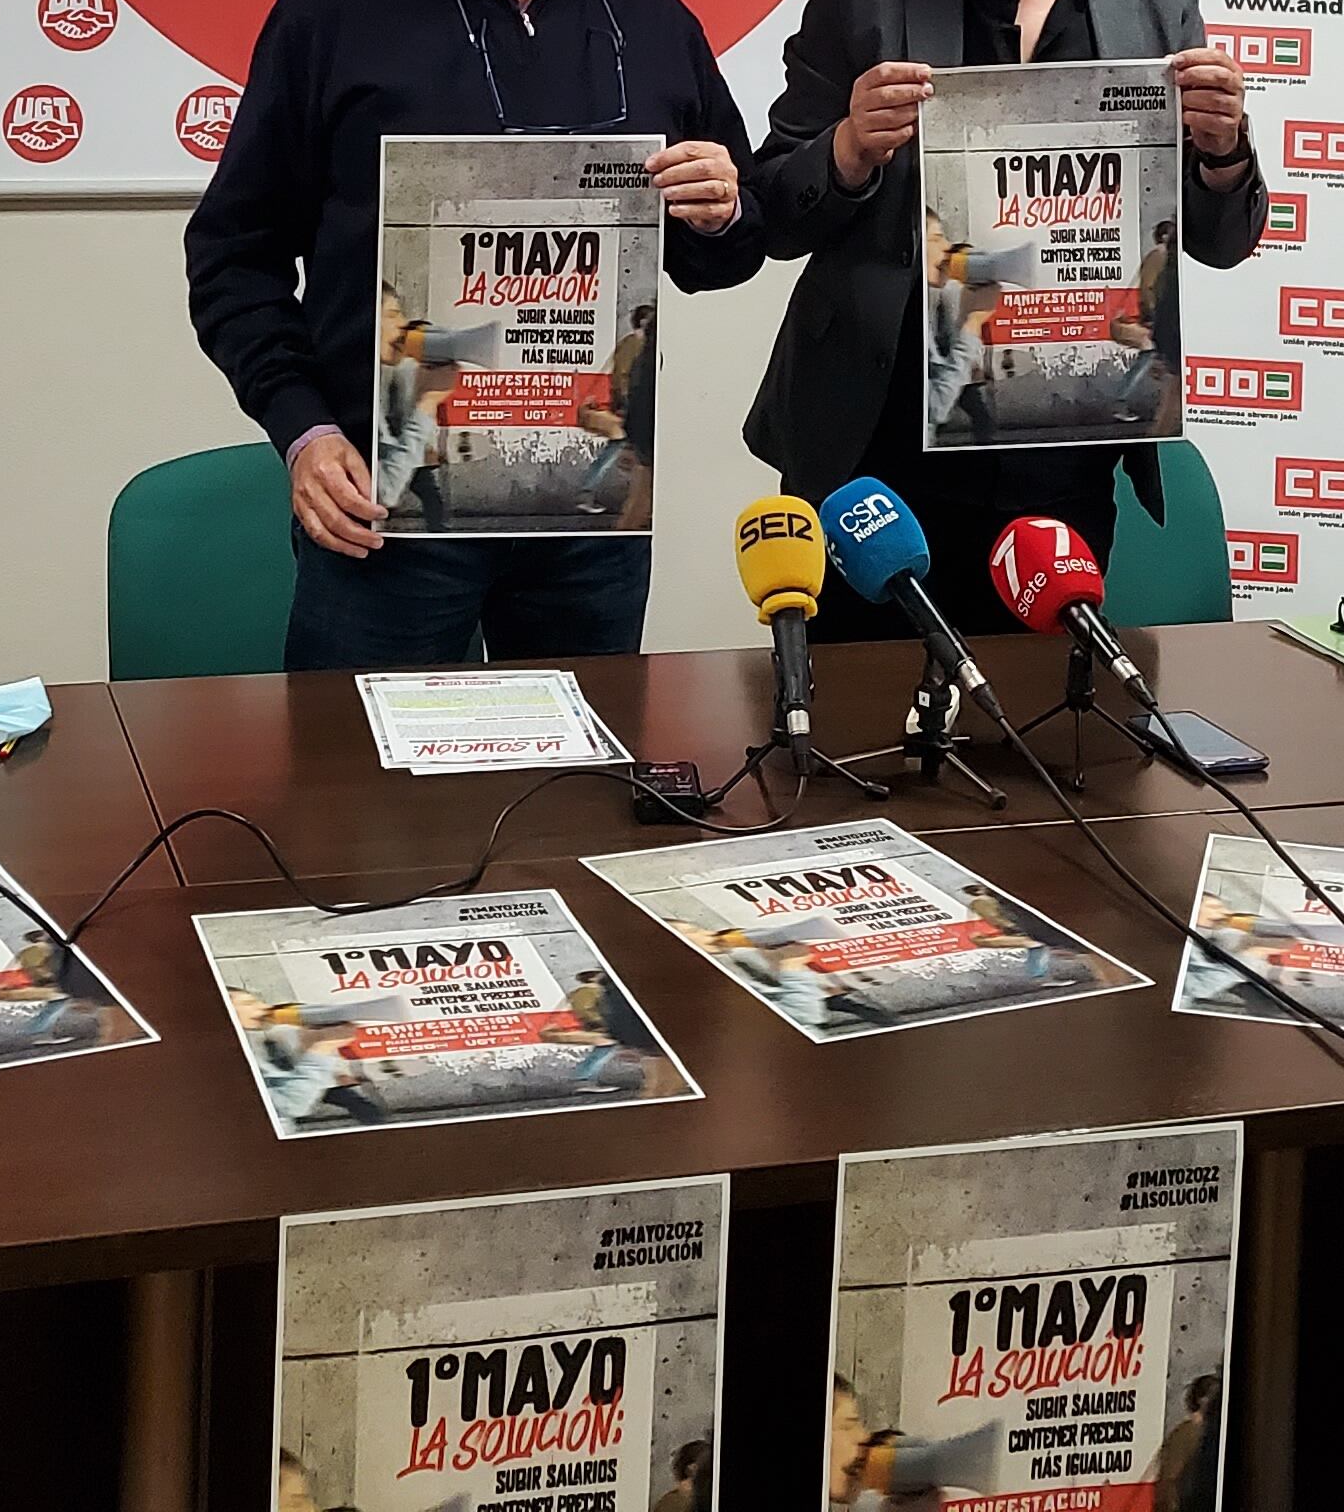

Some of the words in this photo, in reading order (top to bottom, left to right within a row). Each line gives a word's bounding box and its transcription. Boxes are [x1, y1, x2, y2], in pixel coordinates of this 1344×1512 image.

[15, 94, 72, 124] UGT
[1098, 98, 1166, 113] #LASOLUCIÓN
[578, 174, 650, 189] #LASOLUCIÓN
[992, 194, 1021, 230] LA
[1049, 228, 1077, 244] SUBIR
[1079, 227, 1121, 244] SALARIOS
[1040, 247, 1084, 264] CONTENER
[1086, 246, 1121, 263] PRECIOS
[1057, 265, 1077, 283] MÁS
[1079, 265, 1122, 282] IGUALDAD
[454, 275, 485, 307] LA
[516, 308, 546, 325] SUBIR
[549, 308, 595, 325] SALARIOS
[504, 328, 555, 345] CONTENER
[556, 329, 594, 345] PRECIOS
[521, 345, 544, 365] MÁS
[546, 348, 594, 366] IGUALDAD
[462, 373, 573, 388] MANIFESTACIÓN
[524, 409, 548, 421] UGT
[739, 511, 814, 553] SER
[853, 509, 900, 543] Noticias
[1053, 556, 1099, 576] siete
[1017, 571, 1047, 617] siete
[1126, 1165, 1220, 1189] #1MAYO2022
[1119, 1183, 1220, 1211] #LASOLUCIÓN
[600, 1220, 703, 1247] #1MAYO2022
[593, 1238, 703, 1270] #LASOLUCIÓN
[937, 1346, 984, 1406] LA
[1025, 1394, 1068, 1422] SUBIR
[1071, 1389, 1137, 1418] SALARIOS
[396, 1417, 449, 1479] LA
[1008, 1424, 1078, 1454] CONTENER
[1079, 1419, 1135, 1446] PRECIOS
[495, 1465, 543, 1495] SUBIR
[545, 1458, 617, 1488] SALARIOS
[1030, 1450, 1062, 1480] MÁS
[1064, 1448, 1132, 1477] IGUALDAD
